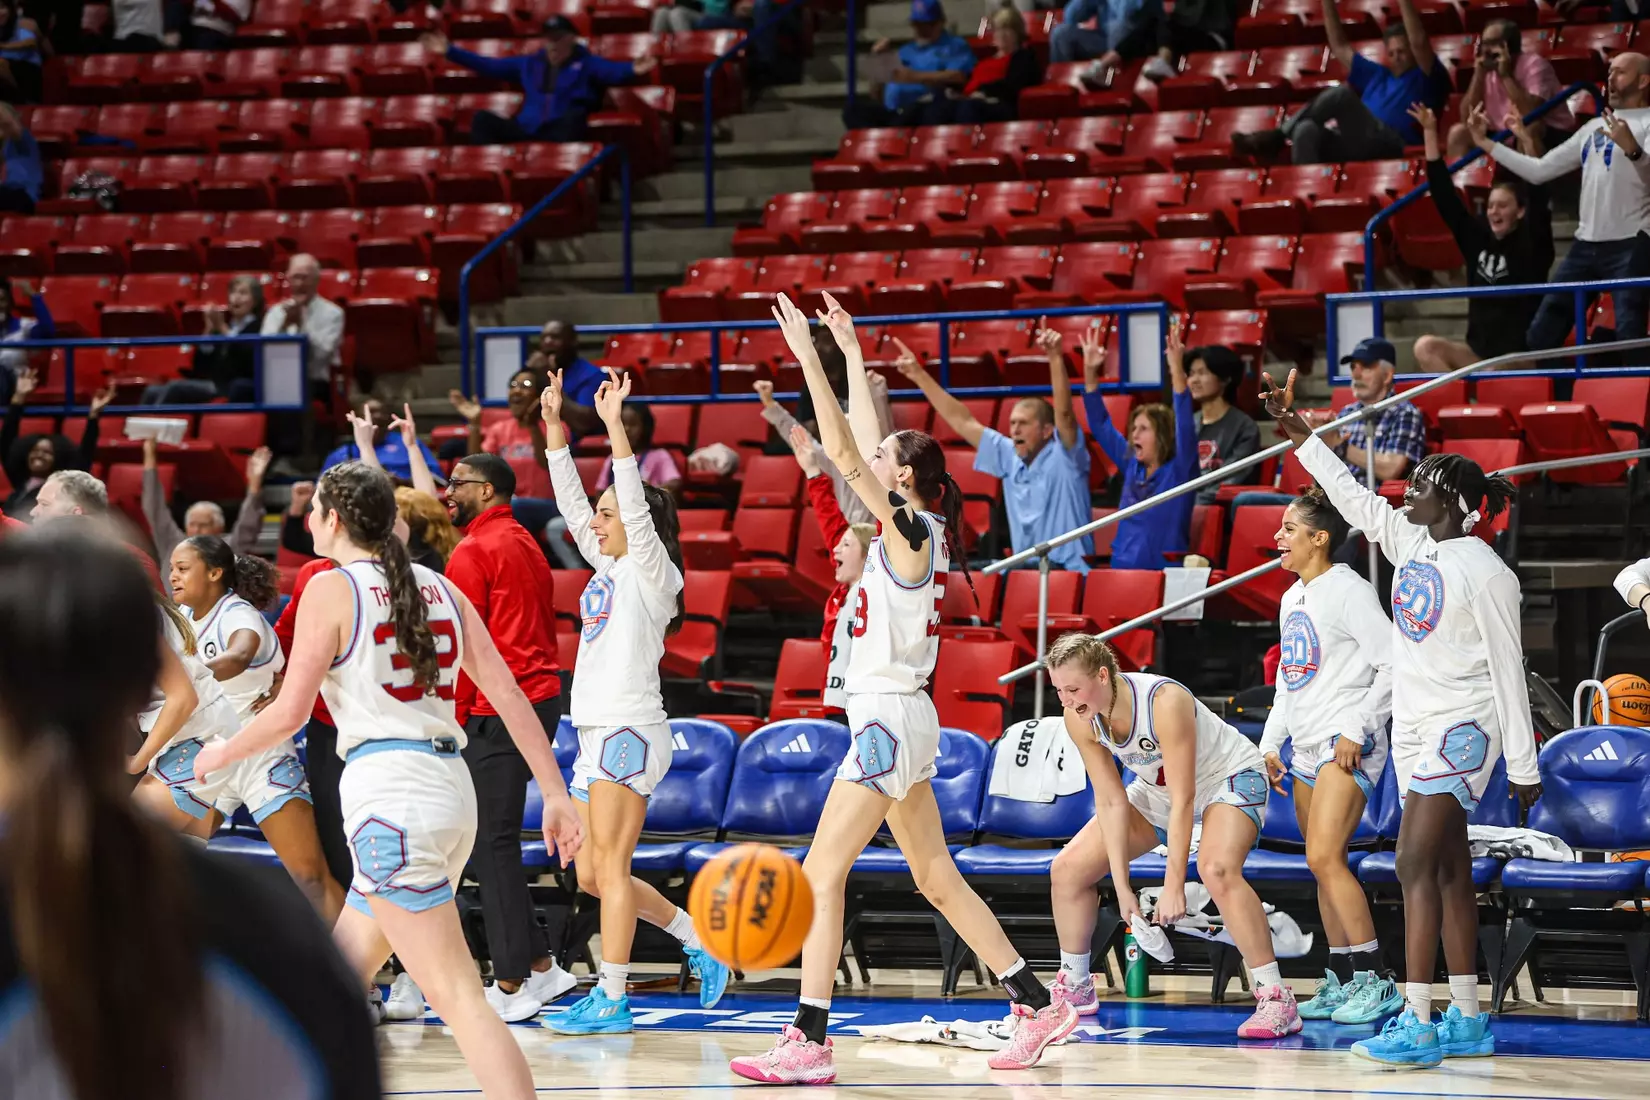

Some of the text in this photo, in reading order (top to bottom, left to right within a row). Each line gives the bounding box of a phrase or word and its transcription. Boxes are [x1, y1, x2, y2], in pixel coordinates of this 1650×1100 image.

[369, 585, 443, 606] THON
[1397, 577, 1431, 622] 50
[1282, 635, 1307, 666] 50
[1621, 700, 1650, 715] lson
[1015, 719, 1039, 768] GATO
